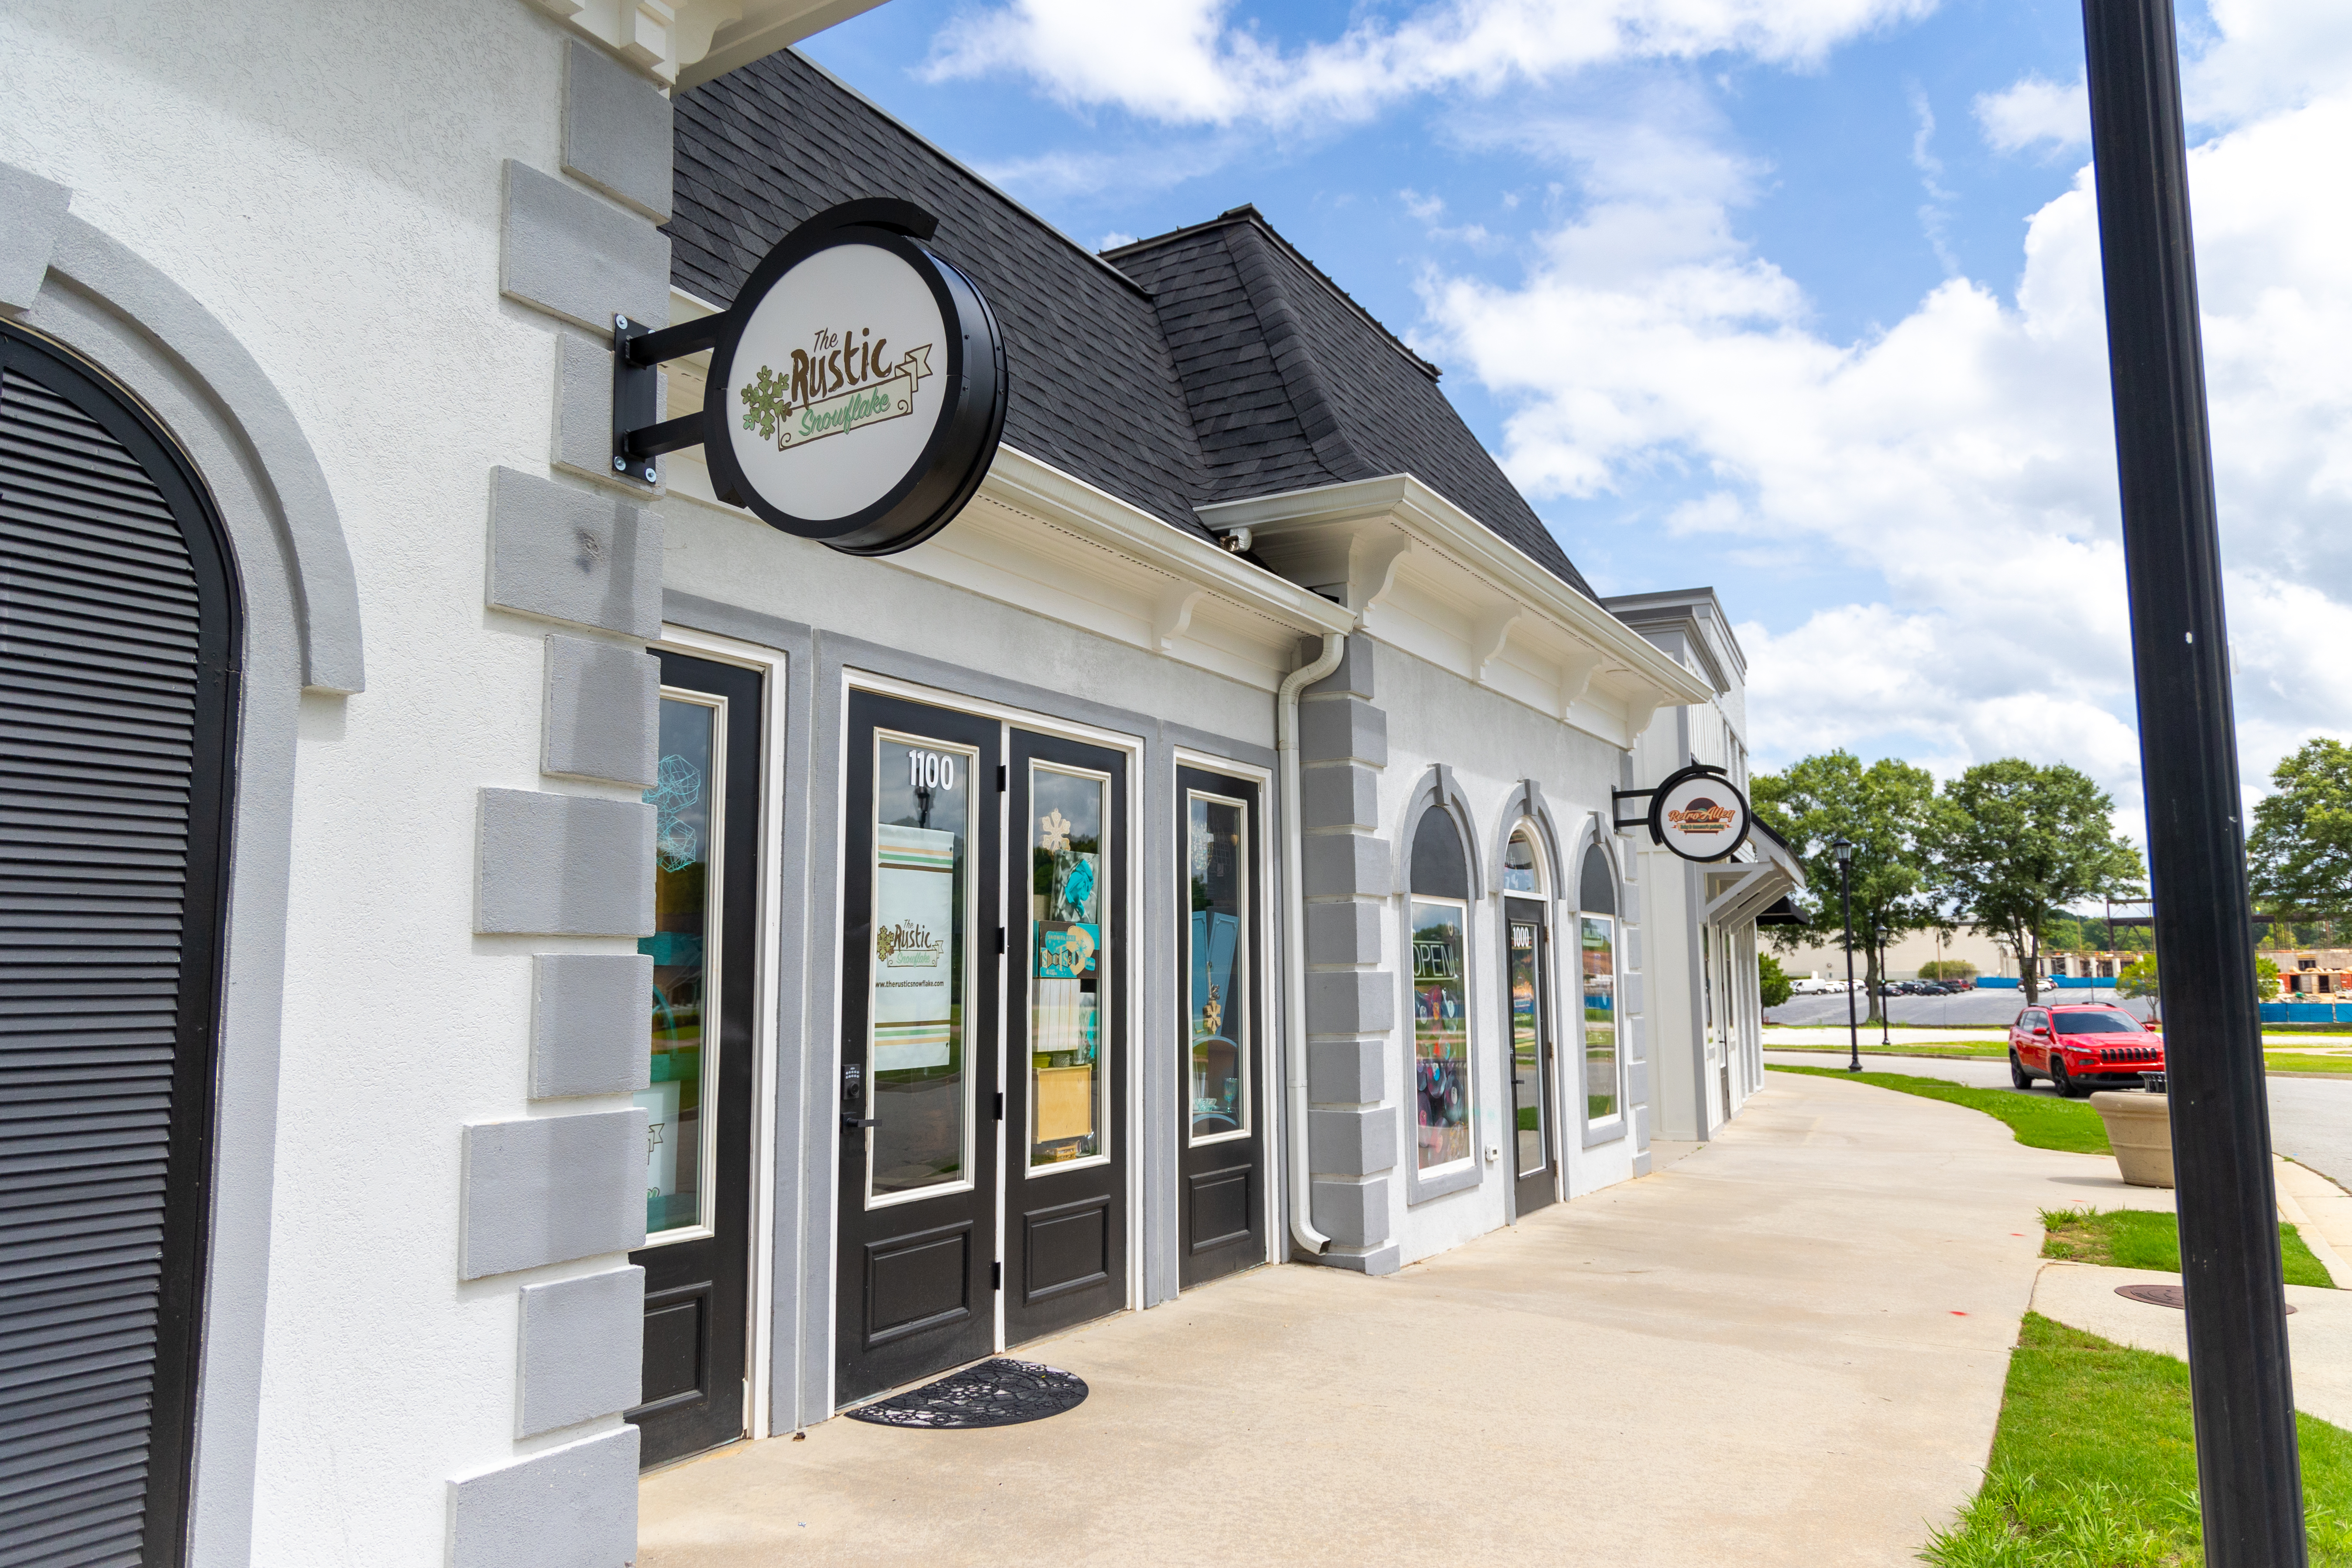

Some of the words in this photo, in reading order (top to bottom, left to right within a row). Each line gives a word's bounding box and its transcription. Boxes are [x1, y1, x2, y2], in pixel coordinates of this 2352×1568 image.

[814, 327, 838, 352] The
[791, 328, 892, 409] Rustic
[798, 386, 891, 435] Snowflake
[909, 750, 954, 790] 1100
[1668, 810, 1700, 822] Retro
[1701, 806, 1735, 822] Alley
[903, 919, 913, 929] The
[1513, 926, 1529, 947] 1000
[894, 924, 931, 952] Rustic
[896, 952, 930, 968] Snowflake
